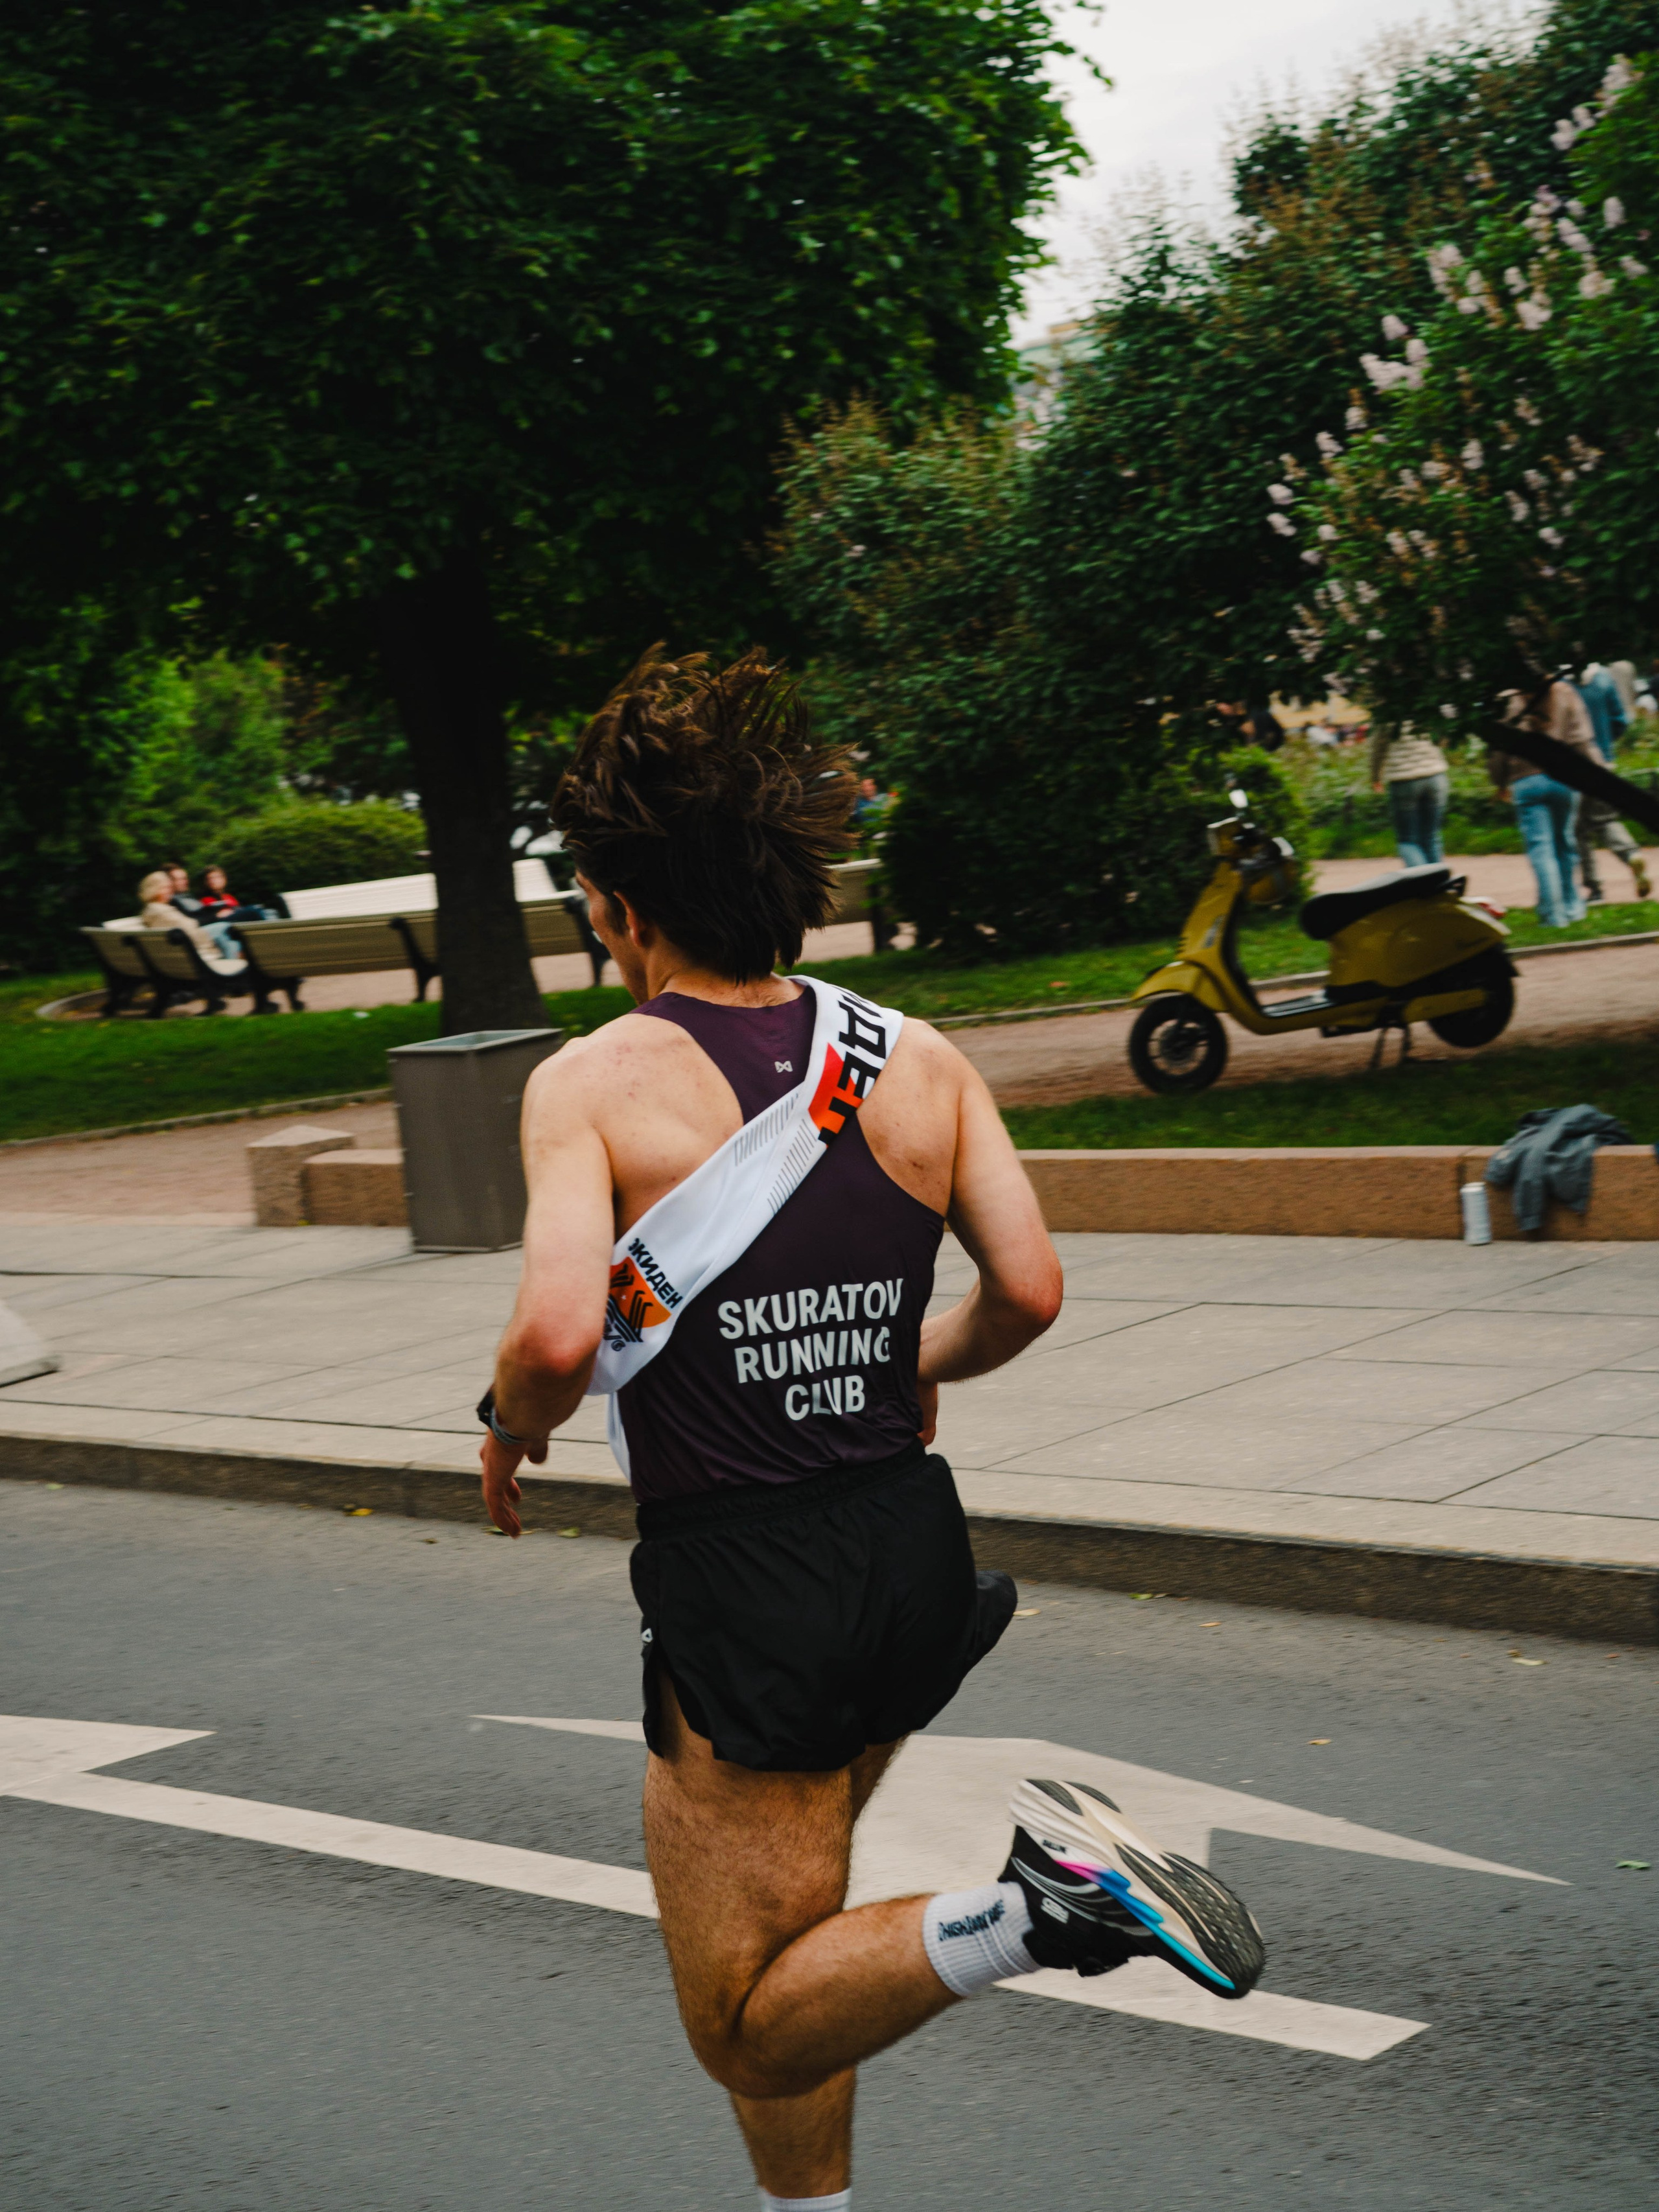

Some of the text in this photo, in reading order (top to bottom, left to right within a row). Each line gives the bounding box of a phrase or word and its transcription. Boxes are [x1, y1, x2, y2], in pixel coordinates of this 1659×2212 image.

[717, 1278, 903, 1340] SKURATOV
[734, 1326, 890, 1383] RUNNING
[785, 1375, 865, 1421] CLUB
